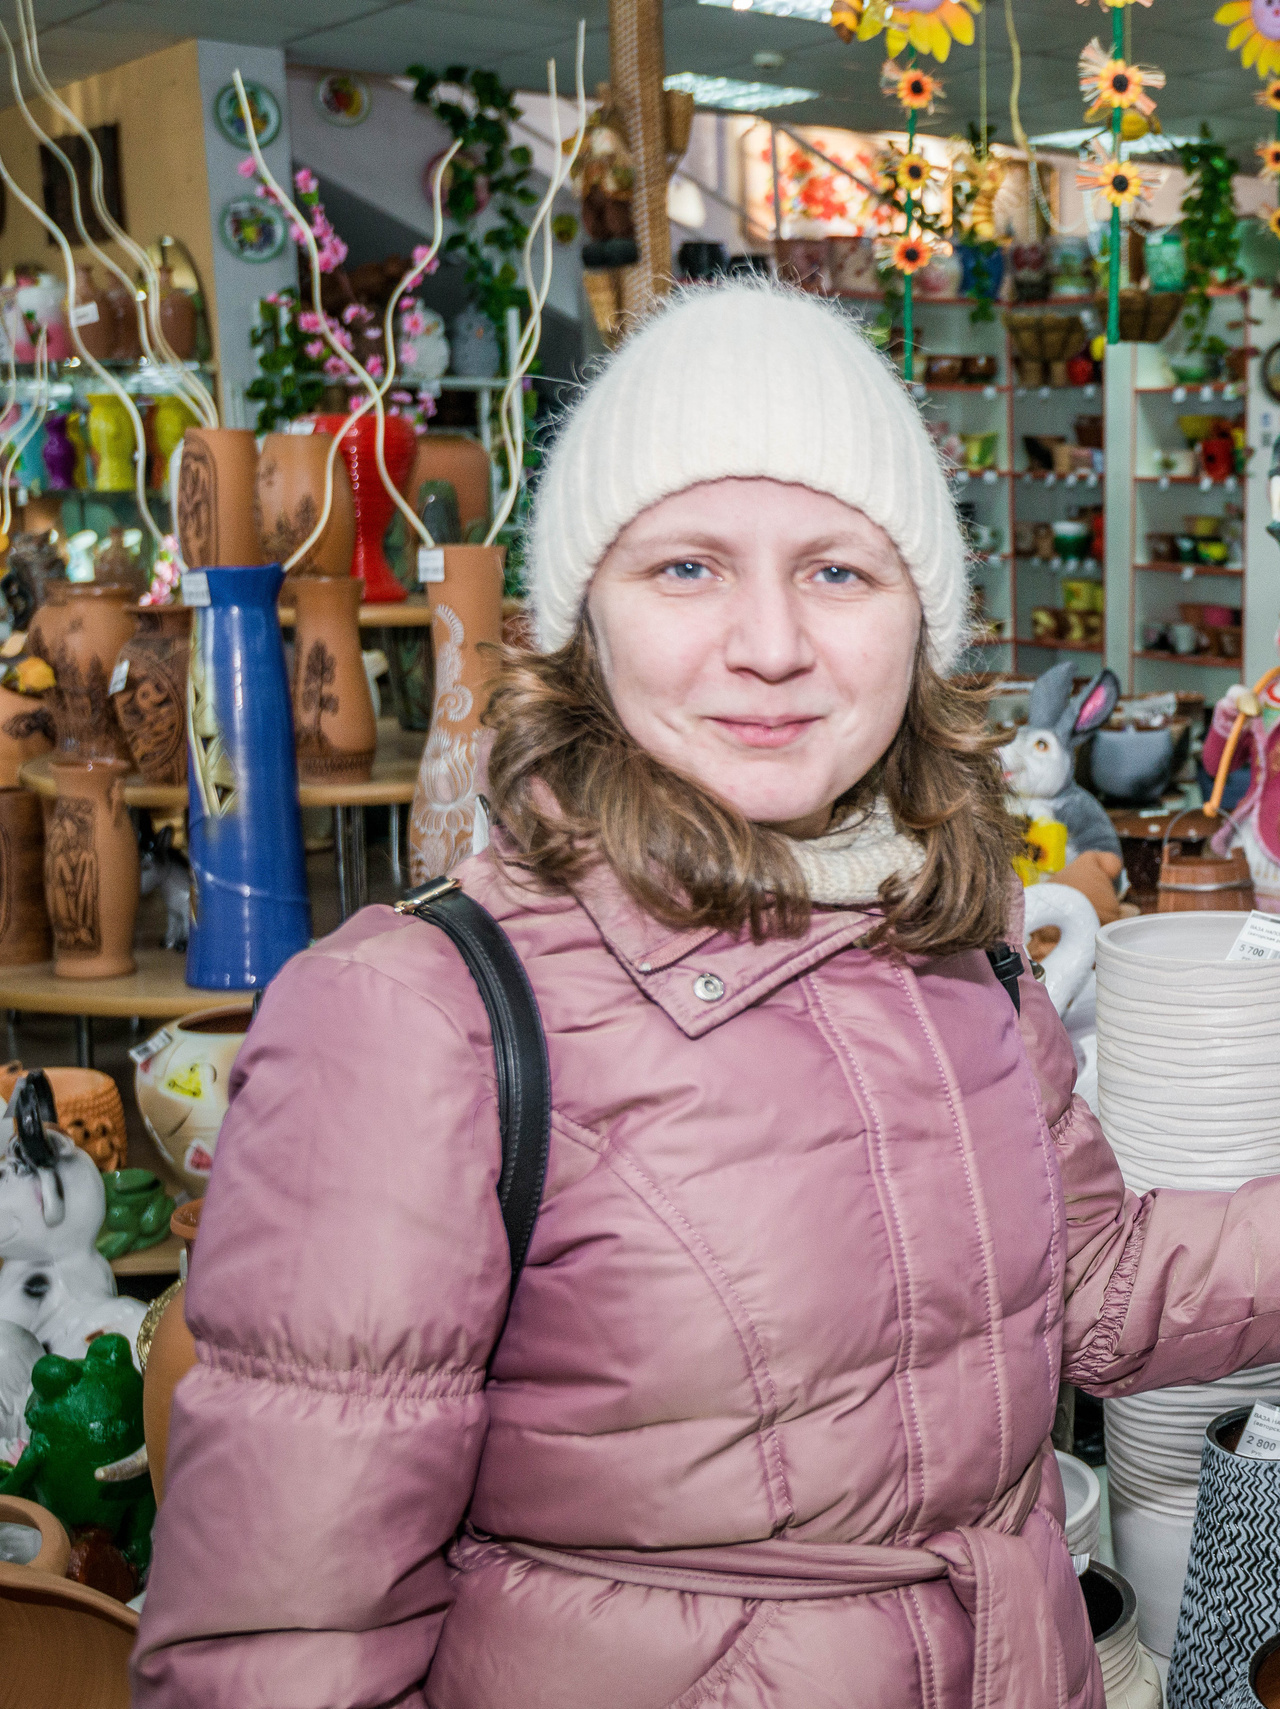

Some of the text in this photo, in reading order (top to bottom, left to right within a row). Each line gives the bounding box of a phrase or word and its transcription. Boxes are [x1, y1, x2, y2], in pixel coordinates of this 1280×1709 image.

[1239, 944, 1265, 957] 5 700
[1253, 1412, 1271, 1422] ВАЗА
[1246, 1435, 1276, 1451] 2 800
